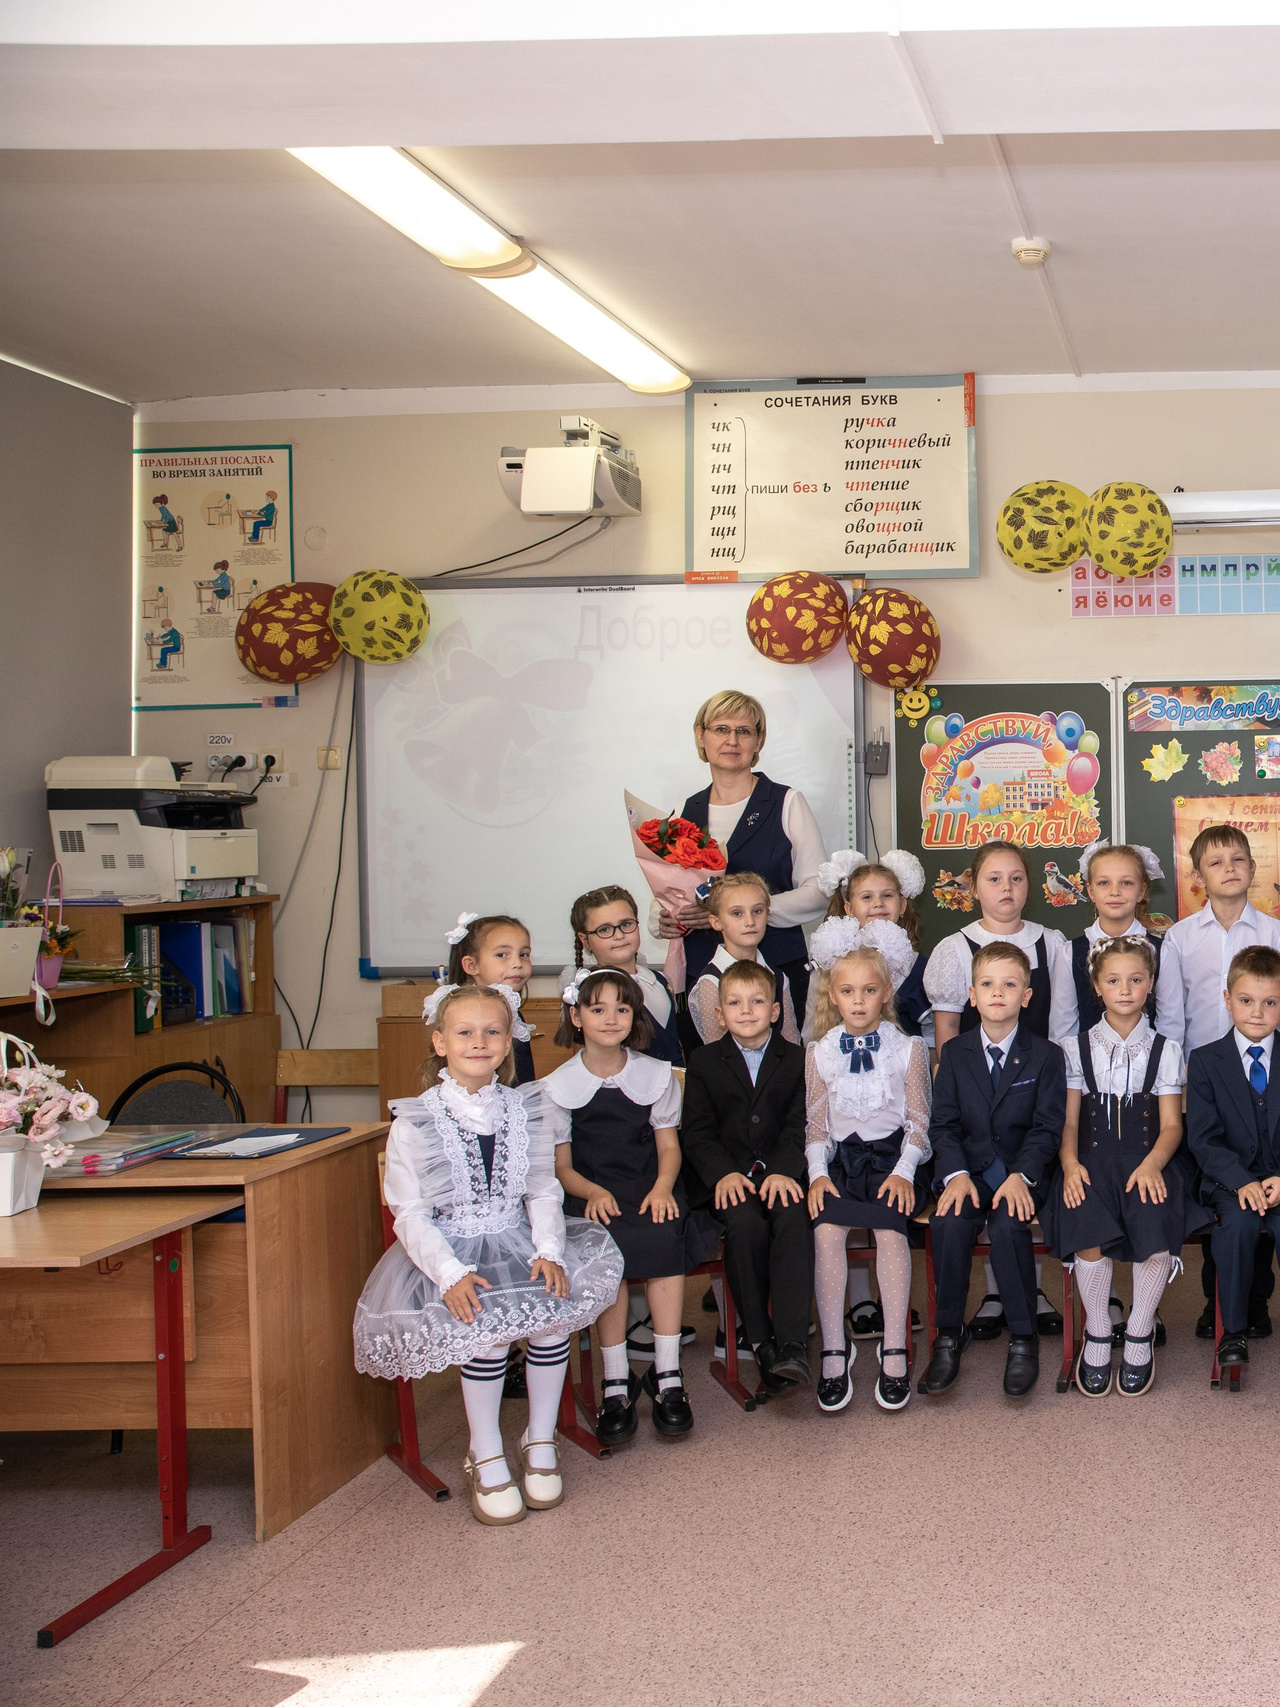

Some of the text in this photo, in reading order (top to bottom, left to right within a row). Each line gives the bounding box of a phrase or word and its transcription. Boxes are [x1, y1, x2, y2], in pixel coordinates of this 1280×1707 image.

[764, 394, 898, 408] СОЧЕТАНИЯ БУКВ
[711, 421, 732, 432] чк
[843, 416, 897, 433] ручка
[711, 442, 732, 453] чн
[844, 433, 951, 453] коричневый
[140, 455, 275, 468] ПРАВИЛЬНАЯ ПОСАДКА
[711, 463, 732, 474] нч
[844, 457, 922, 472] птенчик
[152, 466, 263, 479] ВО ВРЕМЯ ЗАНЯТИЙ
[711, 484, 737, 495] чт
[751, 481, 832, 495] пиши без ь
[845, 479, 910, 493] чтение
[710, 504, 737, 520] рщ
[845, 498, 922, 516] сборщик
[711, 525, 737, 540] щн
[845, 518, 923, 534] овощной
[711, 546, 737, 560] нщ
[845, 540, 956, 558] барабанщик
[1074, 566, 1087, 580] а
[1159, 565, 1172, 578] э
[1182, 564, 1195, 577] н
[1201, 564, 1217, 577] м
[1223, 563, 1238, 577] л
[1245, 563, 1260, 580] р
[1267, 558, 1280, 576] й
[1074, 595, 1088, 608] я
[1095, 591, 1108, 608] ё
[1114, 595, 1133, 608] ю
[1139, 594, 1152, 607] и
[1159, 593, 1173, 607] е
[574, 604, 732, 662] Доброе
[1227, 801, 1236, 815] 1
[924, 809, 1081, 848] Школа!
